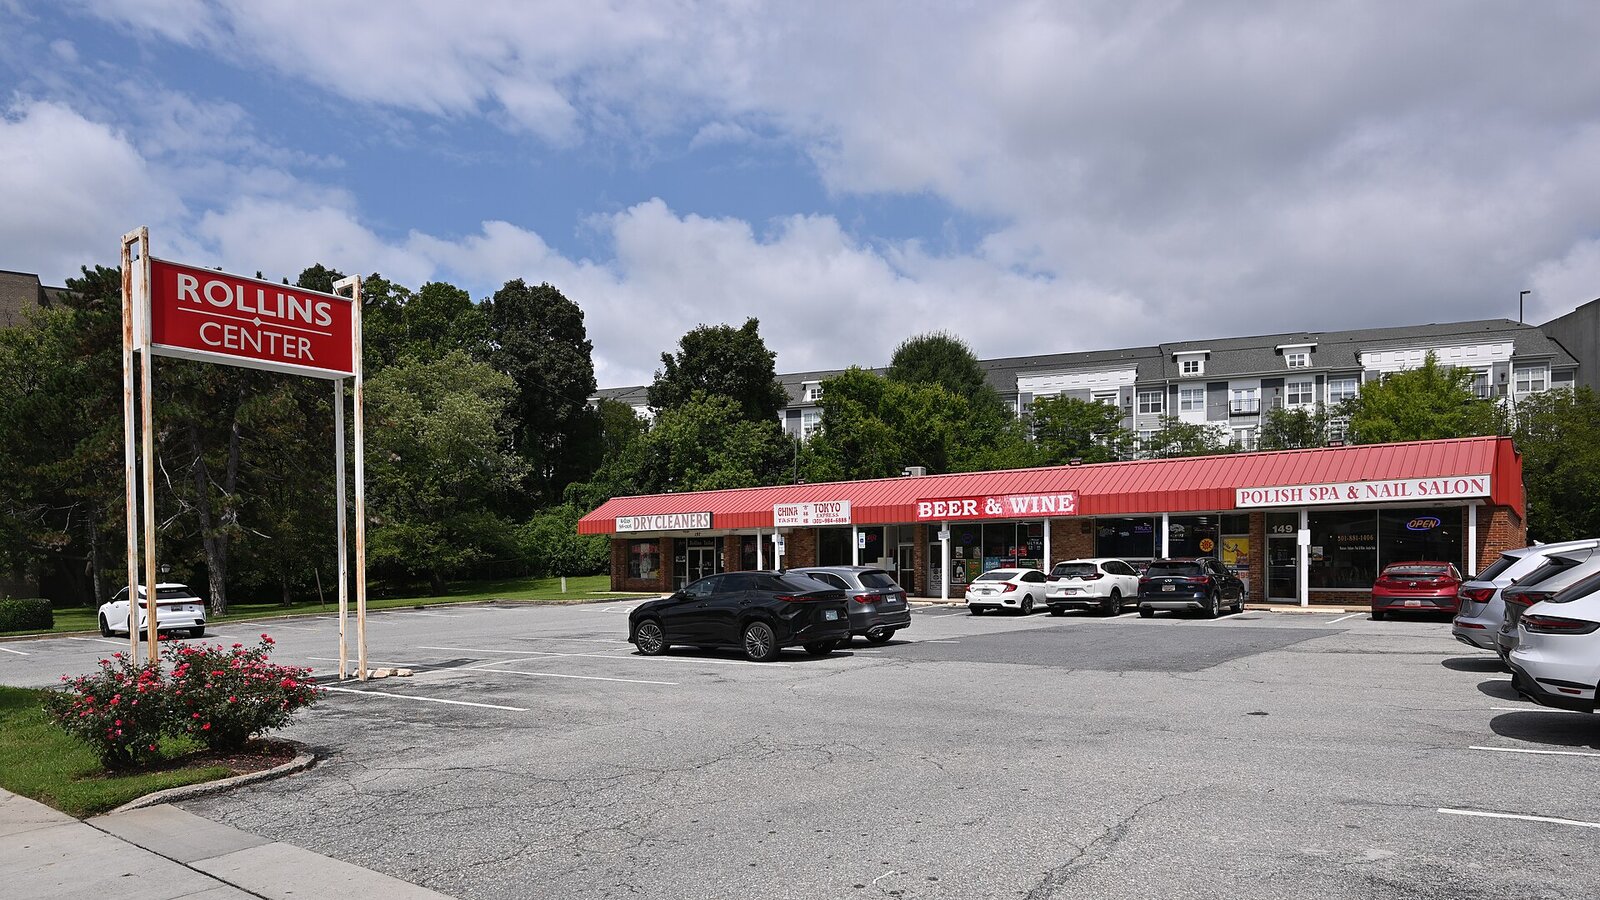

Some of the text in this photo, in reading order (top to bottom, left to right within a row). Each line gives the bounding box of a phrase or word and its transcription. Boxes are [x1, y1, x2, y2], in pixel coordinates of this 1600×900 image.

[177, 273, 333, 327] ROLLINS
[199, 321, 314, 360] CENTER
[1240, 478, 1485, 505] POLISH SPA & NAIL SALON
[777, 506, 798, 516] CHINA
[813, 502, 841, 513] TOKYO
[918, 494, 1075, 518] BEER & WINE
[633, 516, 652, 530] DRY
[655, 513, 709, 529] CLEANERS
[1272, 524, 1293, 534] 149
[1409, 519, 1437, 529] OPEN
